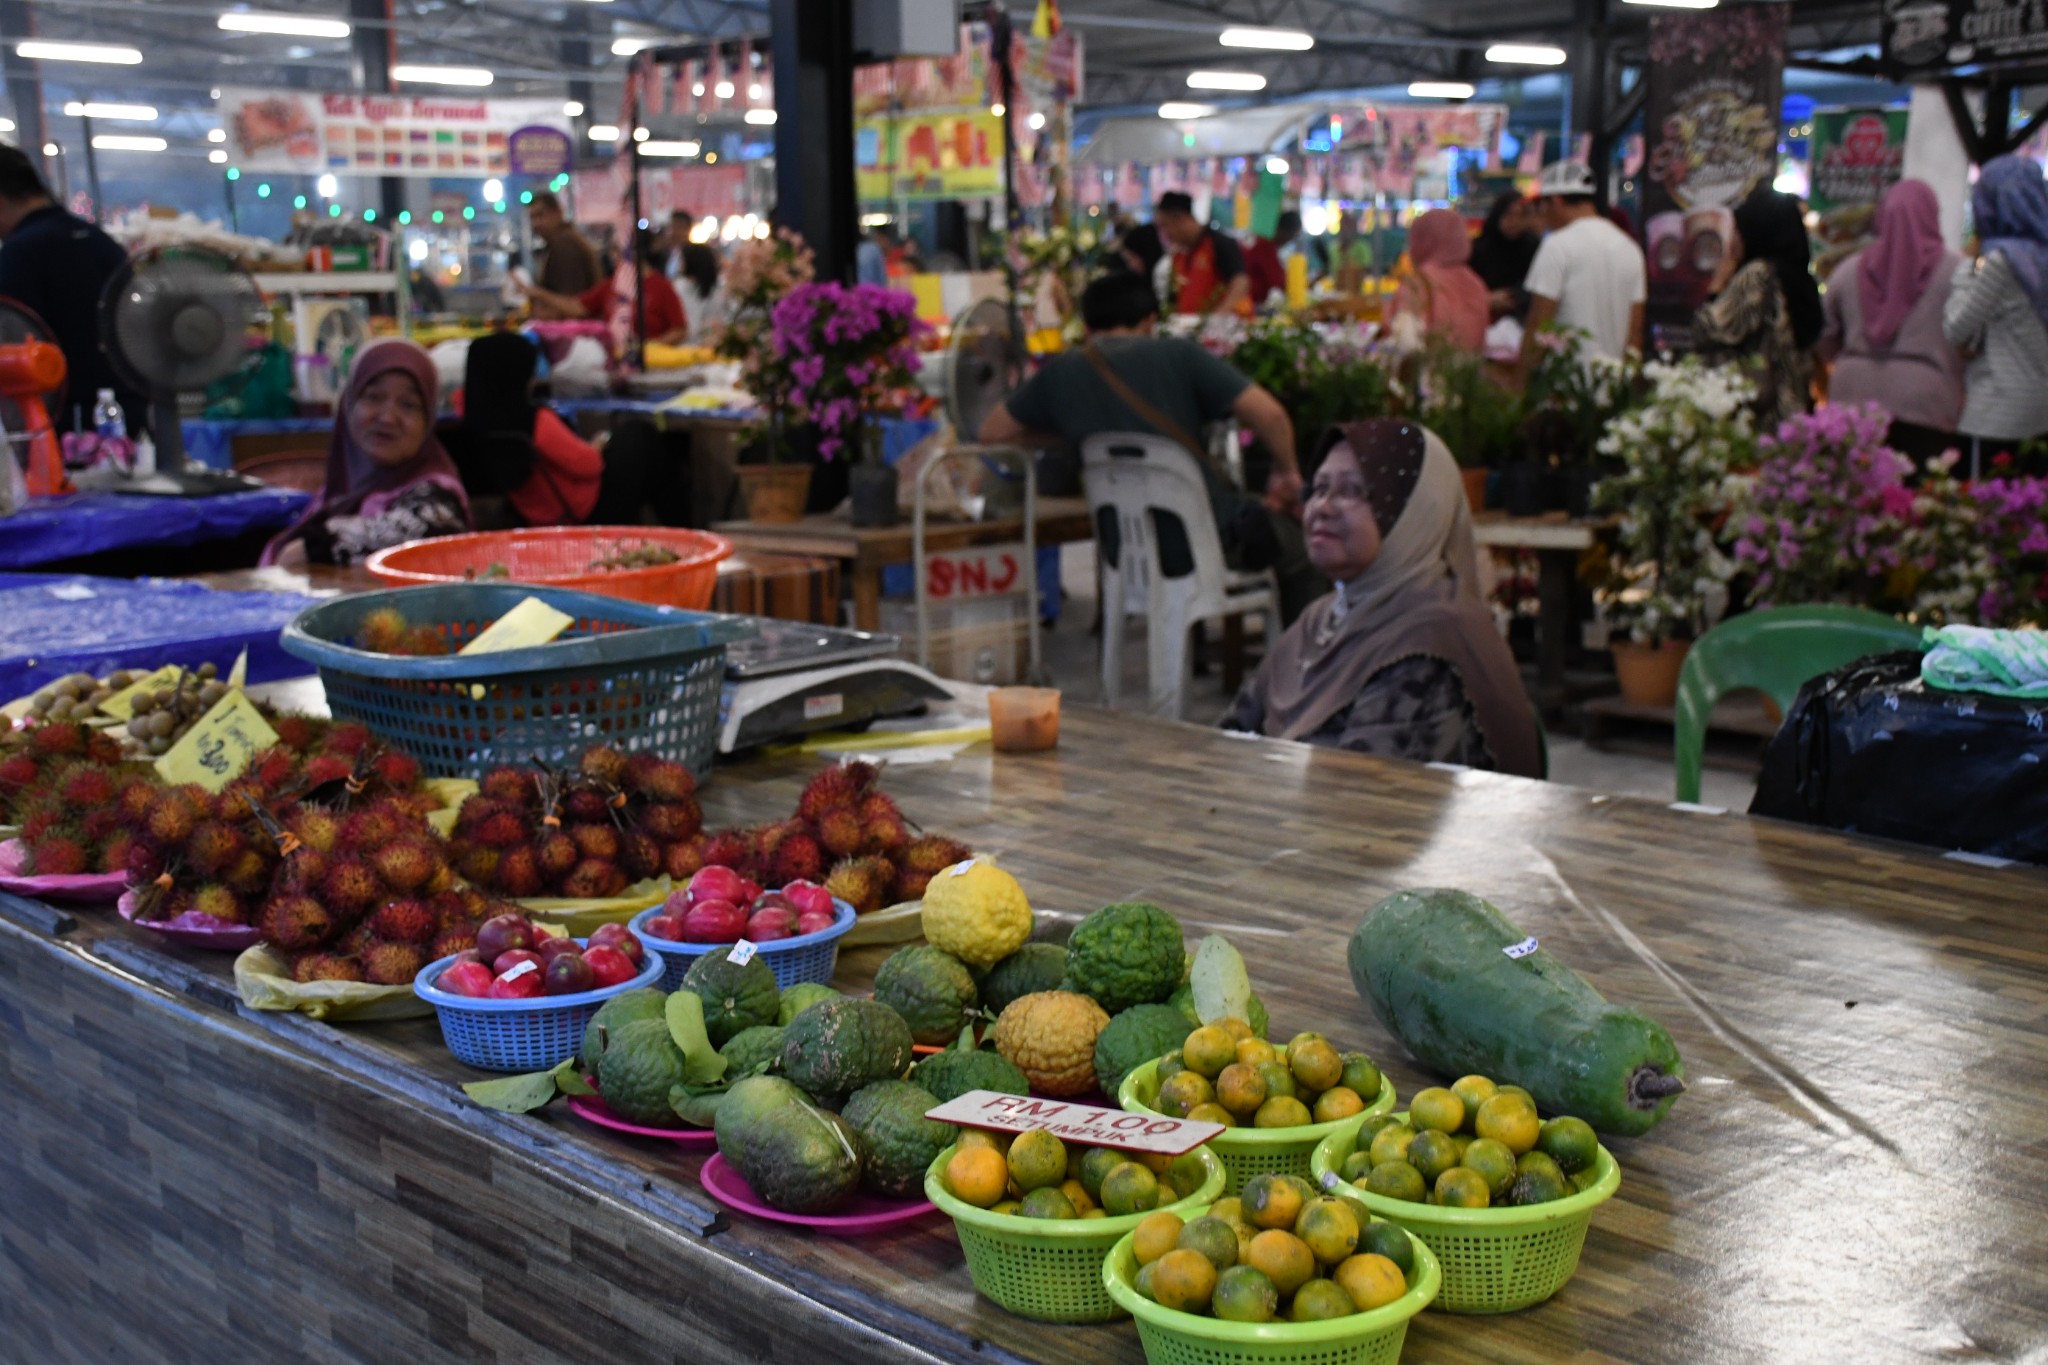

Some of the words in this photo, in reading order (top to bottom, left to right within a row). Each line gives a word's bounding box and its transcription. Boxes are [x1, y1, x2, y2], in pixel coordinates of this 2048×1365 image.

[981, 1095, 1069, 1119] RM
[1083, 1111, 1183, 1137] 1.00
[986, 1114, 1135, 1143] SETUMPUK
